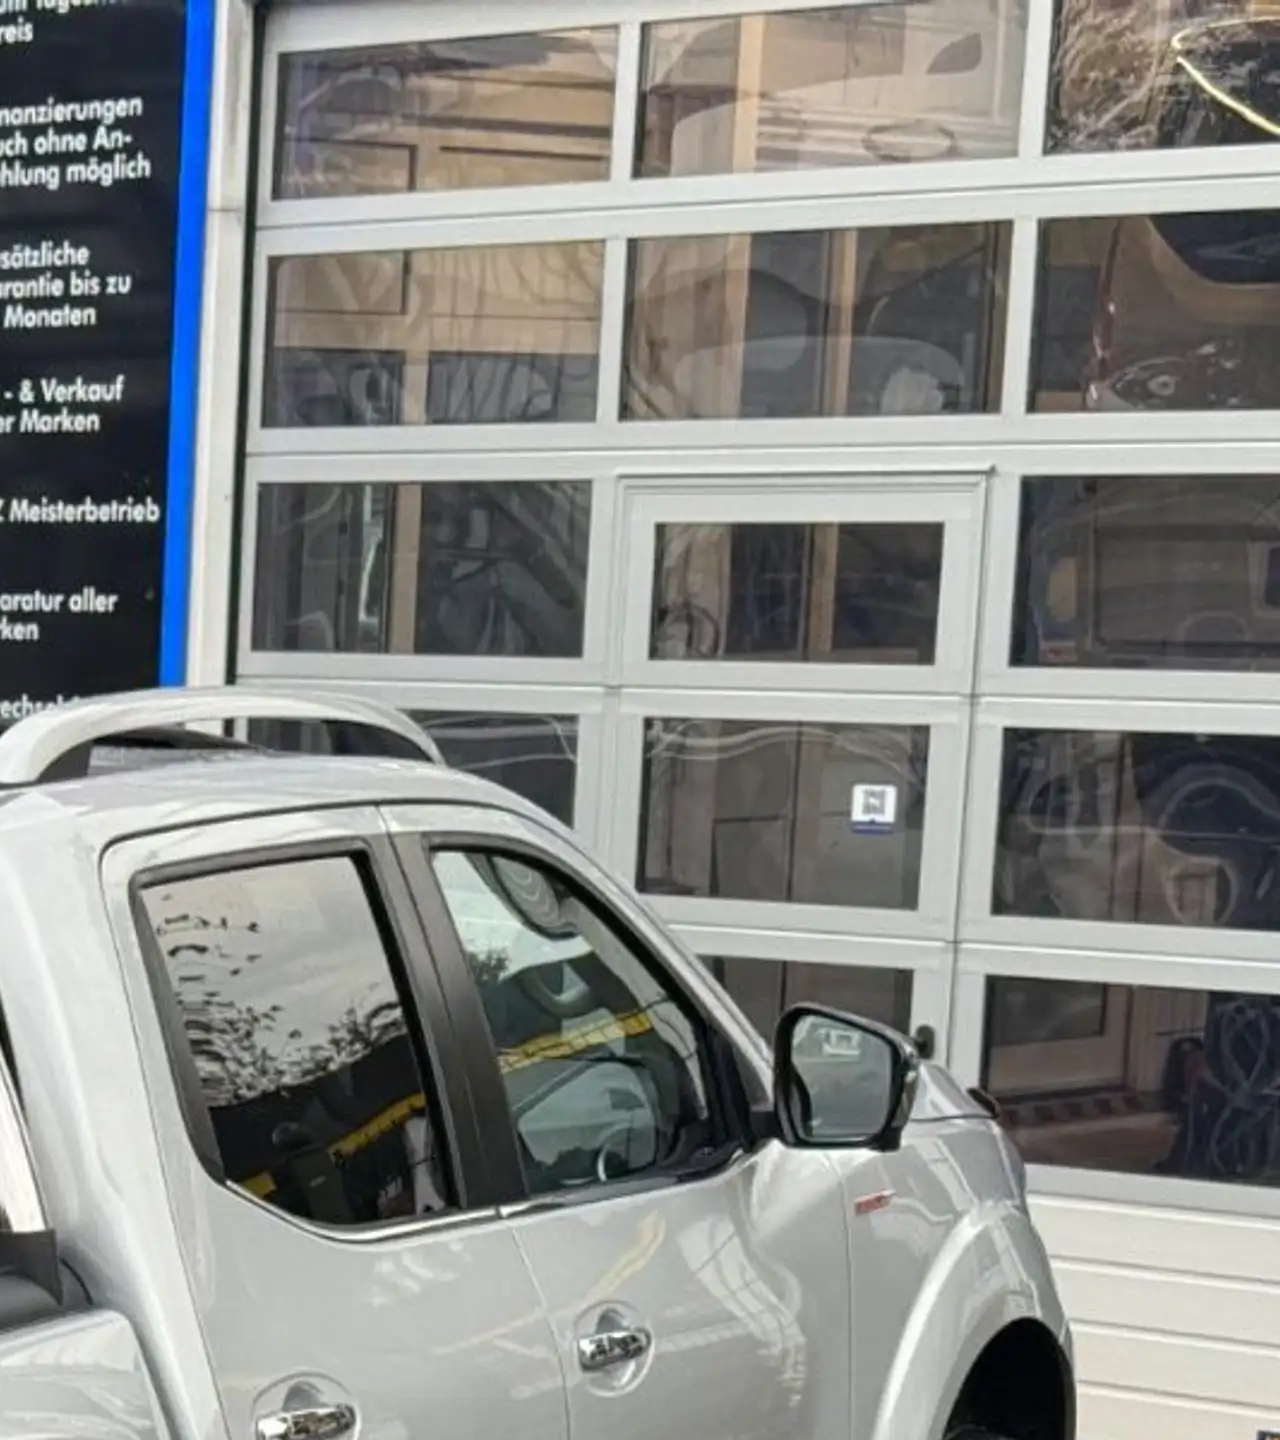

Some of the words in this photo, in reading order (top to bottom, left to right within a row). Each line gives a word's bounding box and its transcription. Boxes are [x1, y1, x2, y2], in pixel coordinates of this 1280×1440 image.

[34, 126, 86, 155] ohne
[92, 124, 132, 149] An-
[66, 154, 151, 188] möglich
[70, 271, 100, 296] bis
[106, 275, 131, 294] zu
[4, 305, 96, 328] Monaten
[20, 379, 35, 403] &
[40, 376, 126, 402] Verkauf
[20, 410, 100, 433] Marken
[10, 497, 160, 522] Meisterbetrieb
[70, 590, 118, 612] aller
